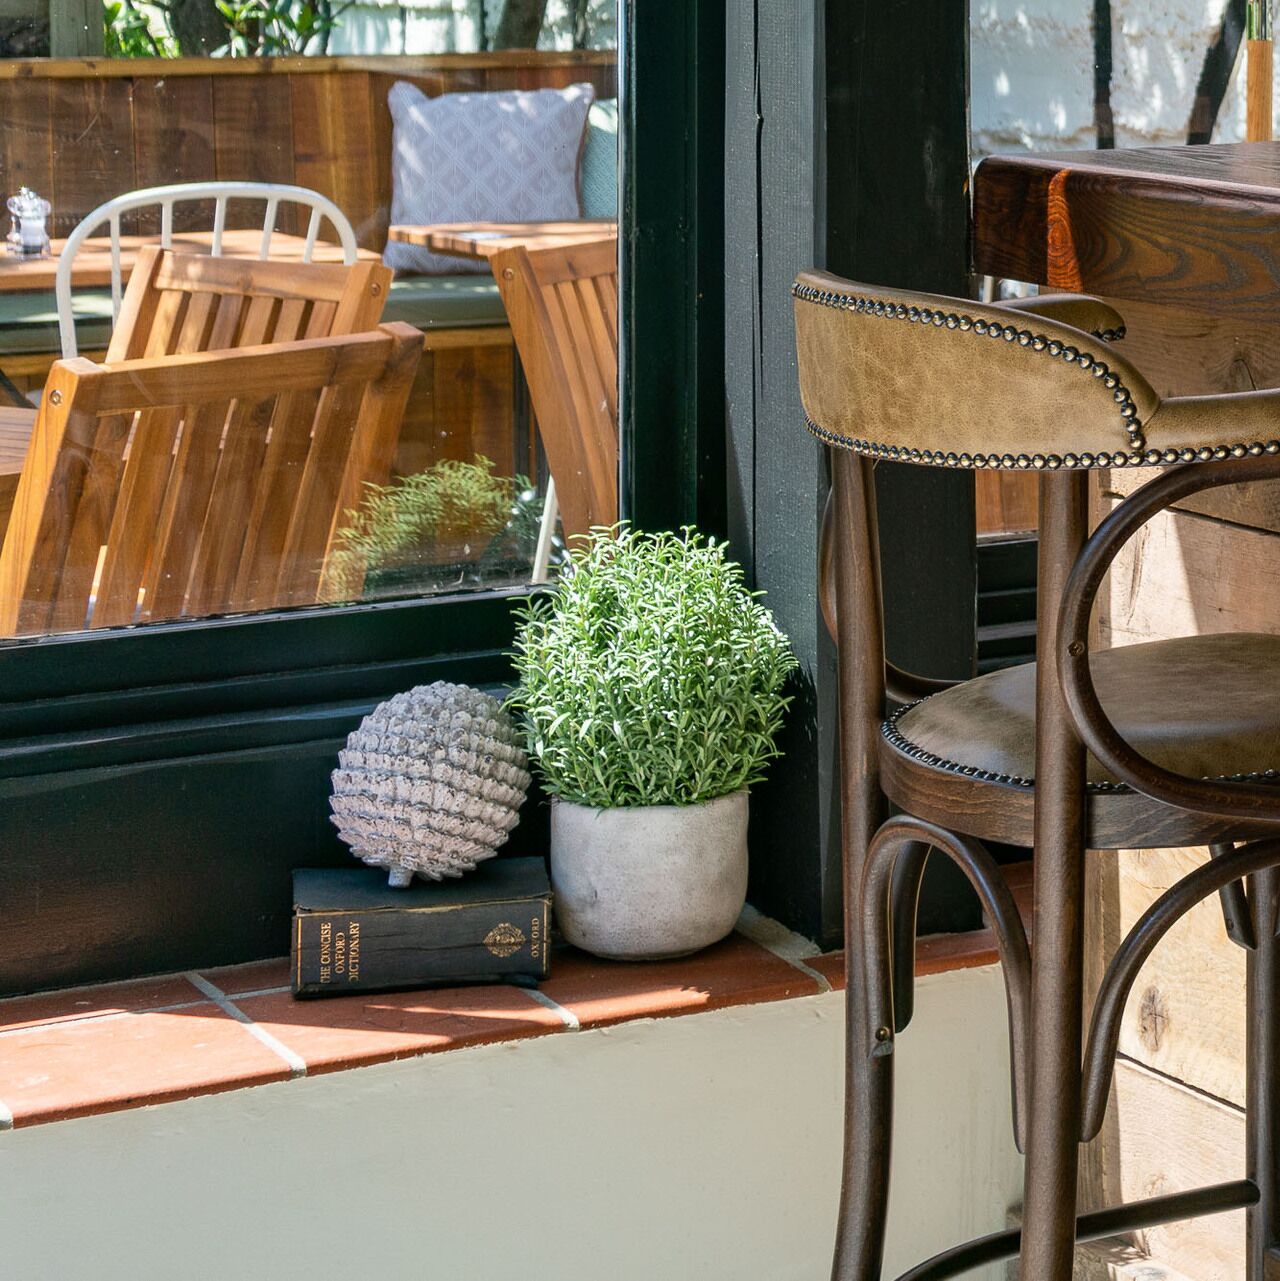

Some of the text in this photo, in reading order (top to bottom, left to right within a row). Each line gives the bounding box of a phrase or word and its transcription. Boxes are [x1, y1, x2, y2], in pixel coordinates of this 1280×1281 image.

[320, 922, 331, 965] CONCISE
[334, 932, 345, 974] OXFORD
[348, 921, 360, 982] DICTIONARY
